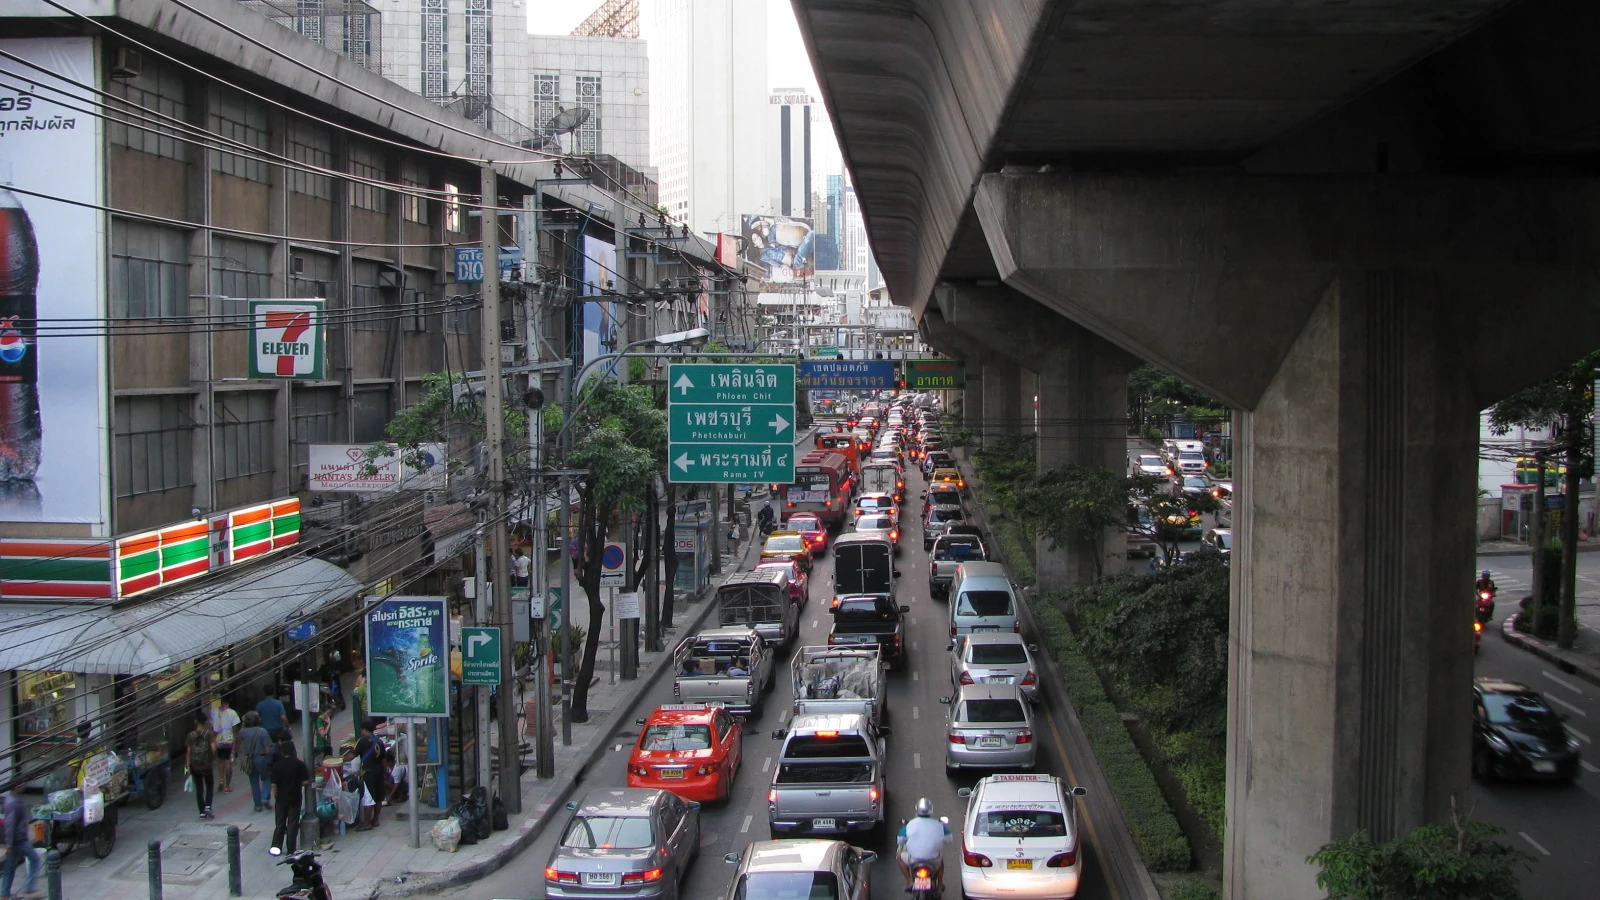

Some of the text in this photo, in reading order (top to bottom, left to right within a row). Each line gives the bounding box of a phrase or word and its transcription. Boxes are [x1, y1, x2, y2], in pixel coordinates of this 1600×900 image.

[784, 95, 809, 105] SQUARE
[710, 368, 777, 388] เพลินจิต
[753, 392, 772, 400] Chit
[687, 406, 752, 431] เพชรบุรี
[700, 445, 788, 467] พระรามที่ ๔
[314, 473, 353, 481] NANTA'S
[355, 473, 397, 481] JEWELRY
[399, 606, 427, 619] อิสระ
[398, 618, 433, 629] กระหาย
[407, 654, 438, 673] Sprite
